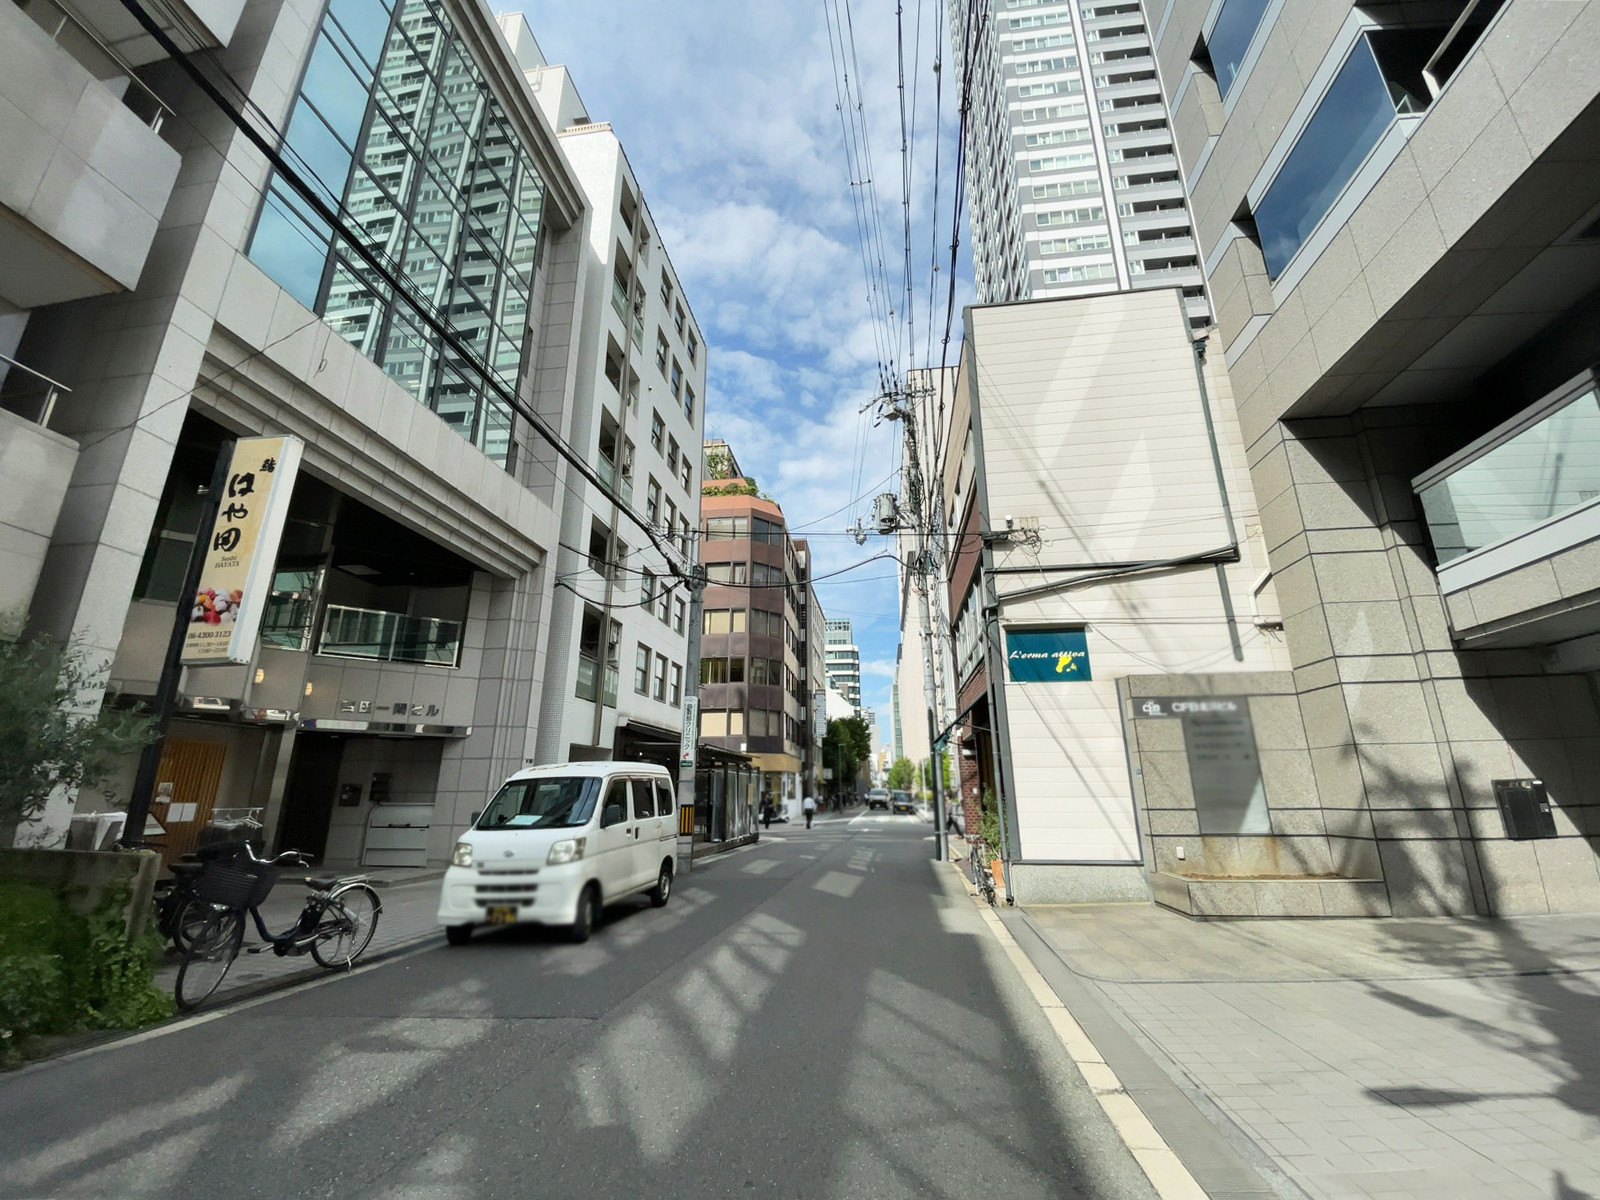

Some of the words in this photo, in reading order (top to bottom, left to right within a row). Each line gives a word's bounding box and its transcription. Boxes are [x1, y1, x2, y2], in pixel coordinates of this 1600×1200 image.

[260, 457, 276, 473] 鮨
[213, 472, 255, 552] はや田
[221, 555, 237, 563] Sushi
[214, 561, 240, 569] HAYATA
[1009, 650, 1048, 660] L'orma
